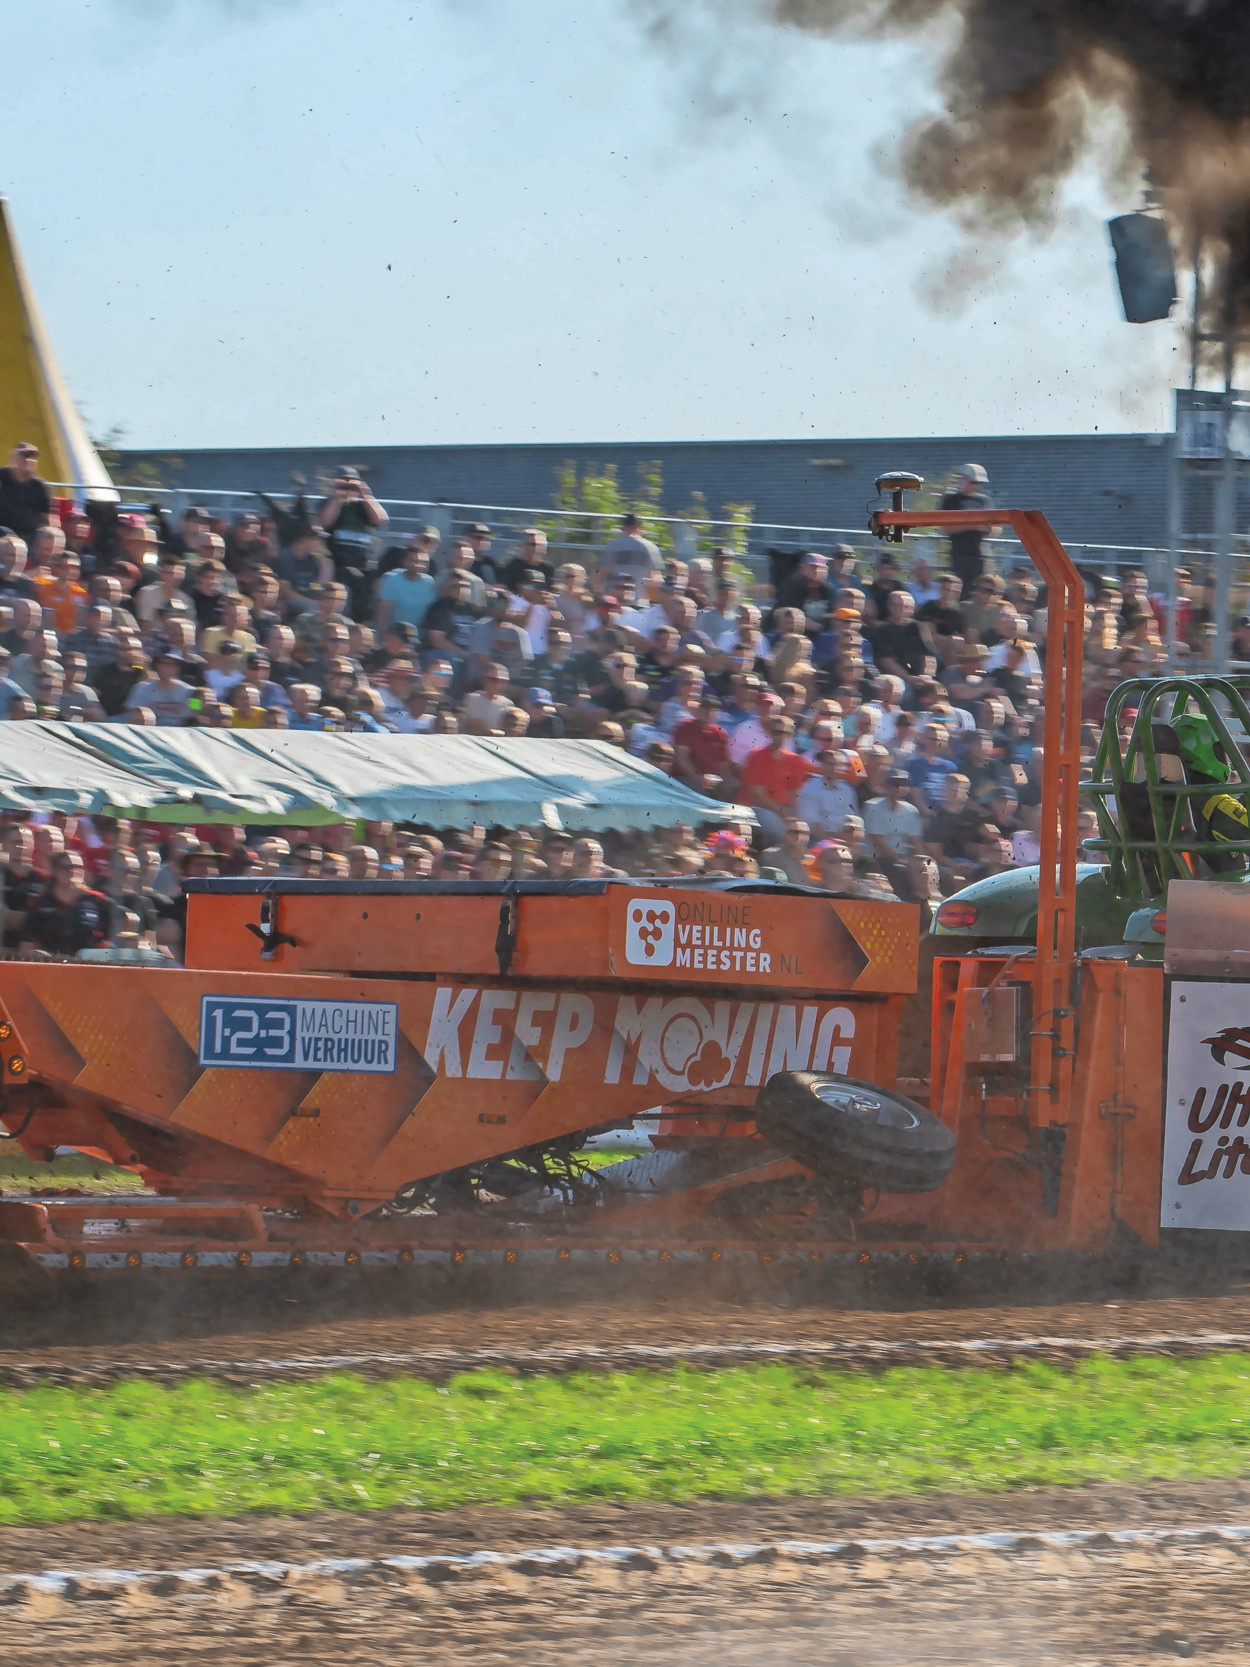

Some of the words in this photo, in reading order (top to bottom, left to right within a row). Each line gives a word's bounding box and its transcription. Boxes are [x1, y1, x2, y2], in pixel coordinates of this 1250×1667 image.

[678, 902, 752, 925] ONLINE
[677, 924, 762, 949] VEILING
[301, 1007, 391, 1036] MACHINE
[301, 1036, 390, 1065] VERHUUR
[422, 987, 595, 1082] KEEP
[604, 994, 857, 1092] MOVING
